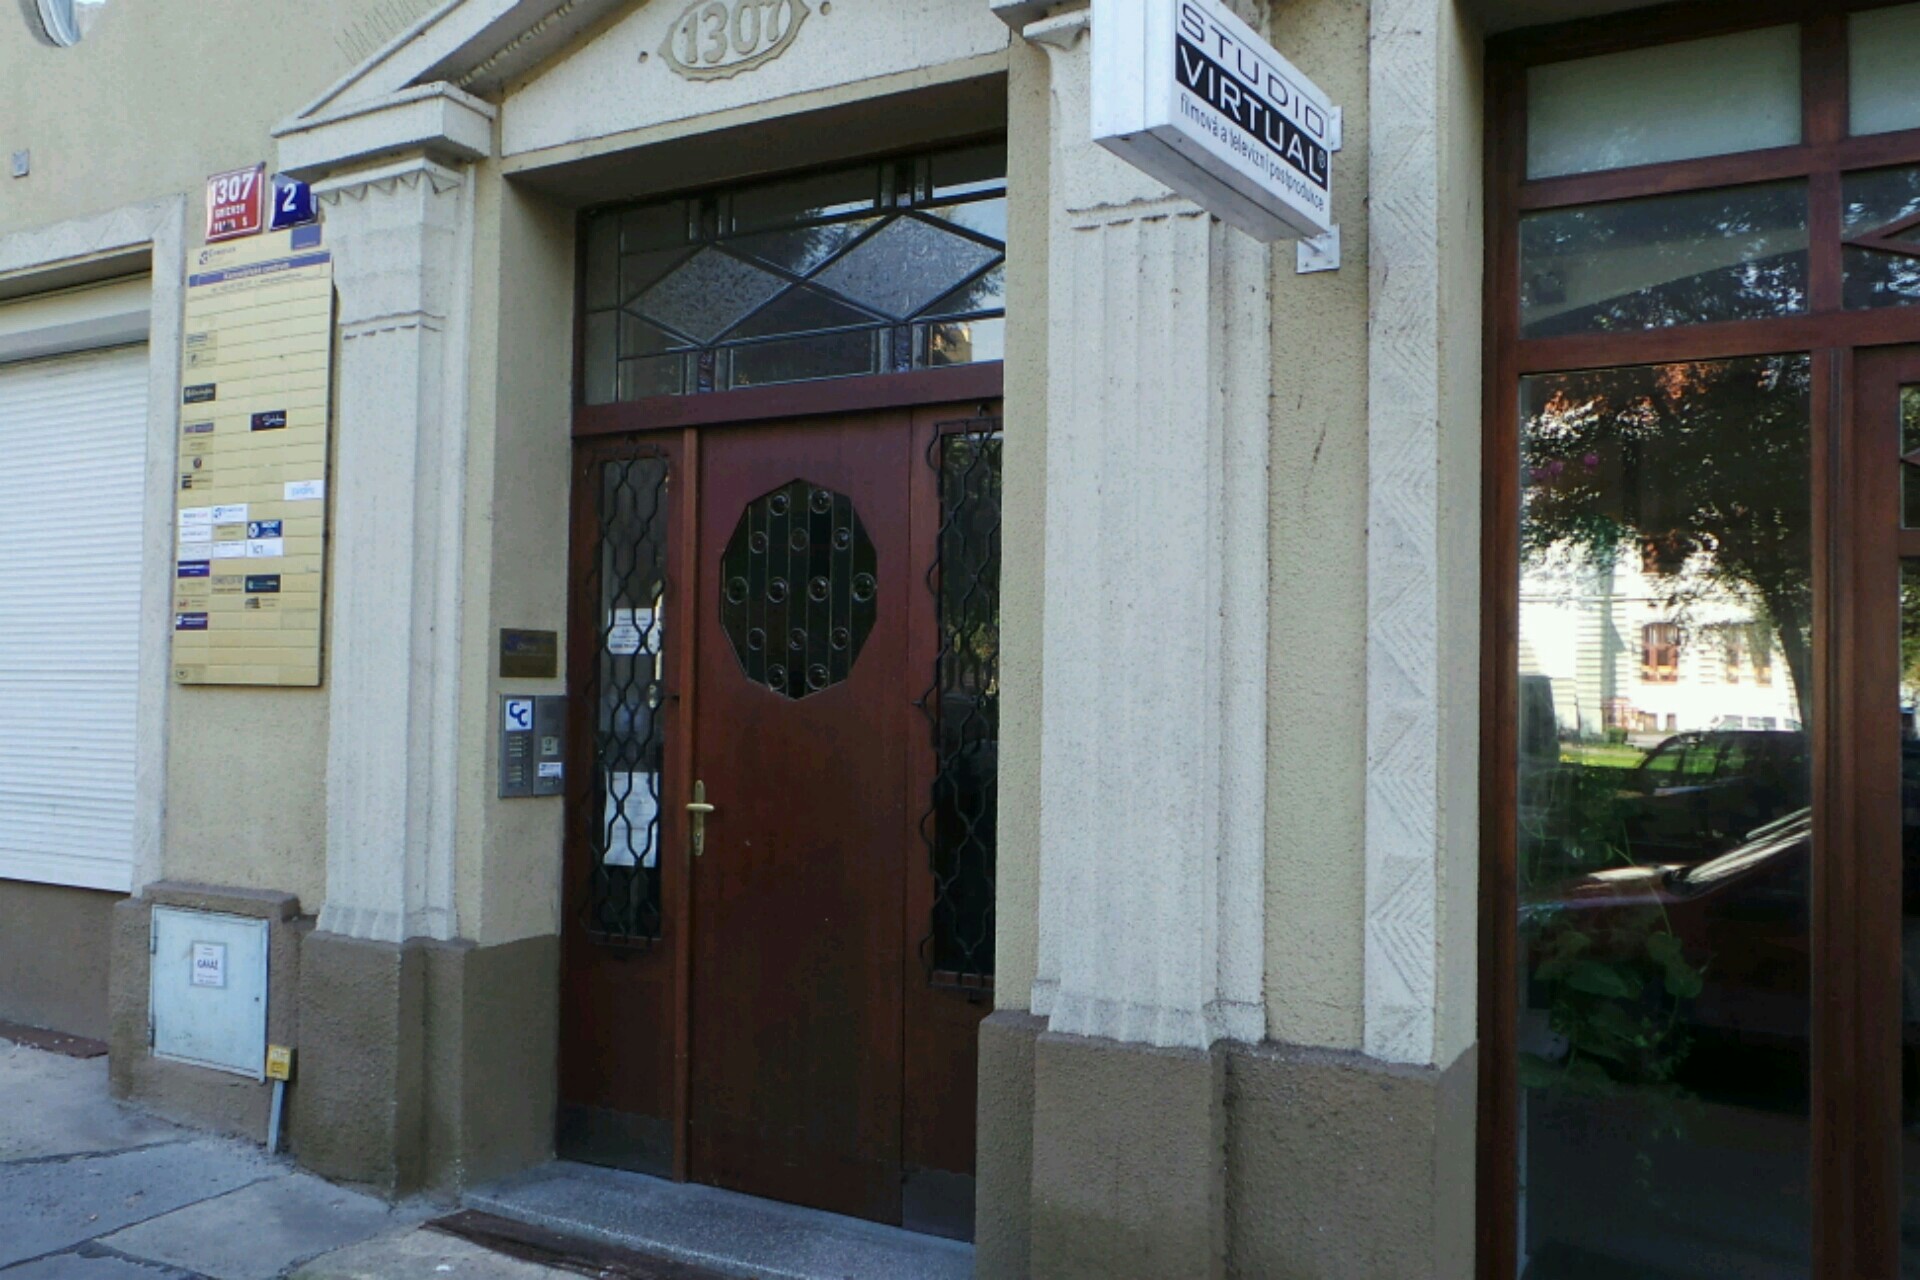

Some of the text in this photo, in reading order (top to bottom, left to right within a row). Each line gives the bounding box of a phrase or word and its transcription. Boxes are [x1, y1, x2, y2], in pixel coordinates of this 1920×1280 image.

[682, 0, 784, 64] 1307
[1181, 3, 1325, 139] STUDIO
[210, 172, 255, 206] 1307
[282, 182, 297, 212] 2
[1220, 126, 1228, 144] a
[1269, 161, 1325, 212] postprodukce
